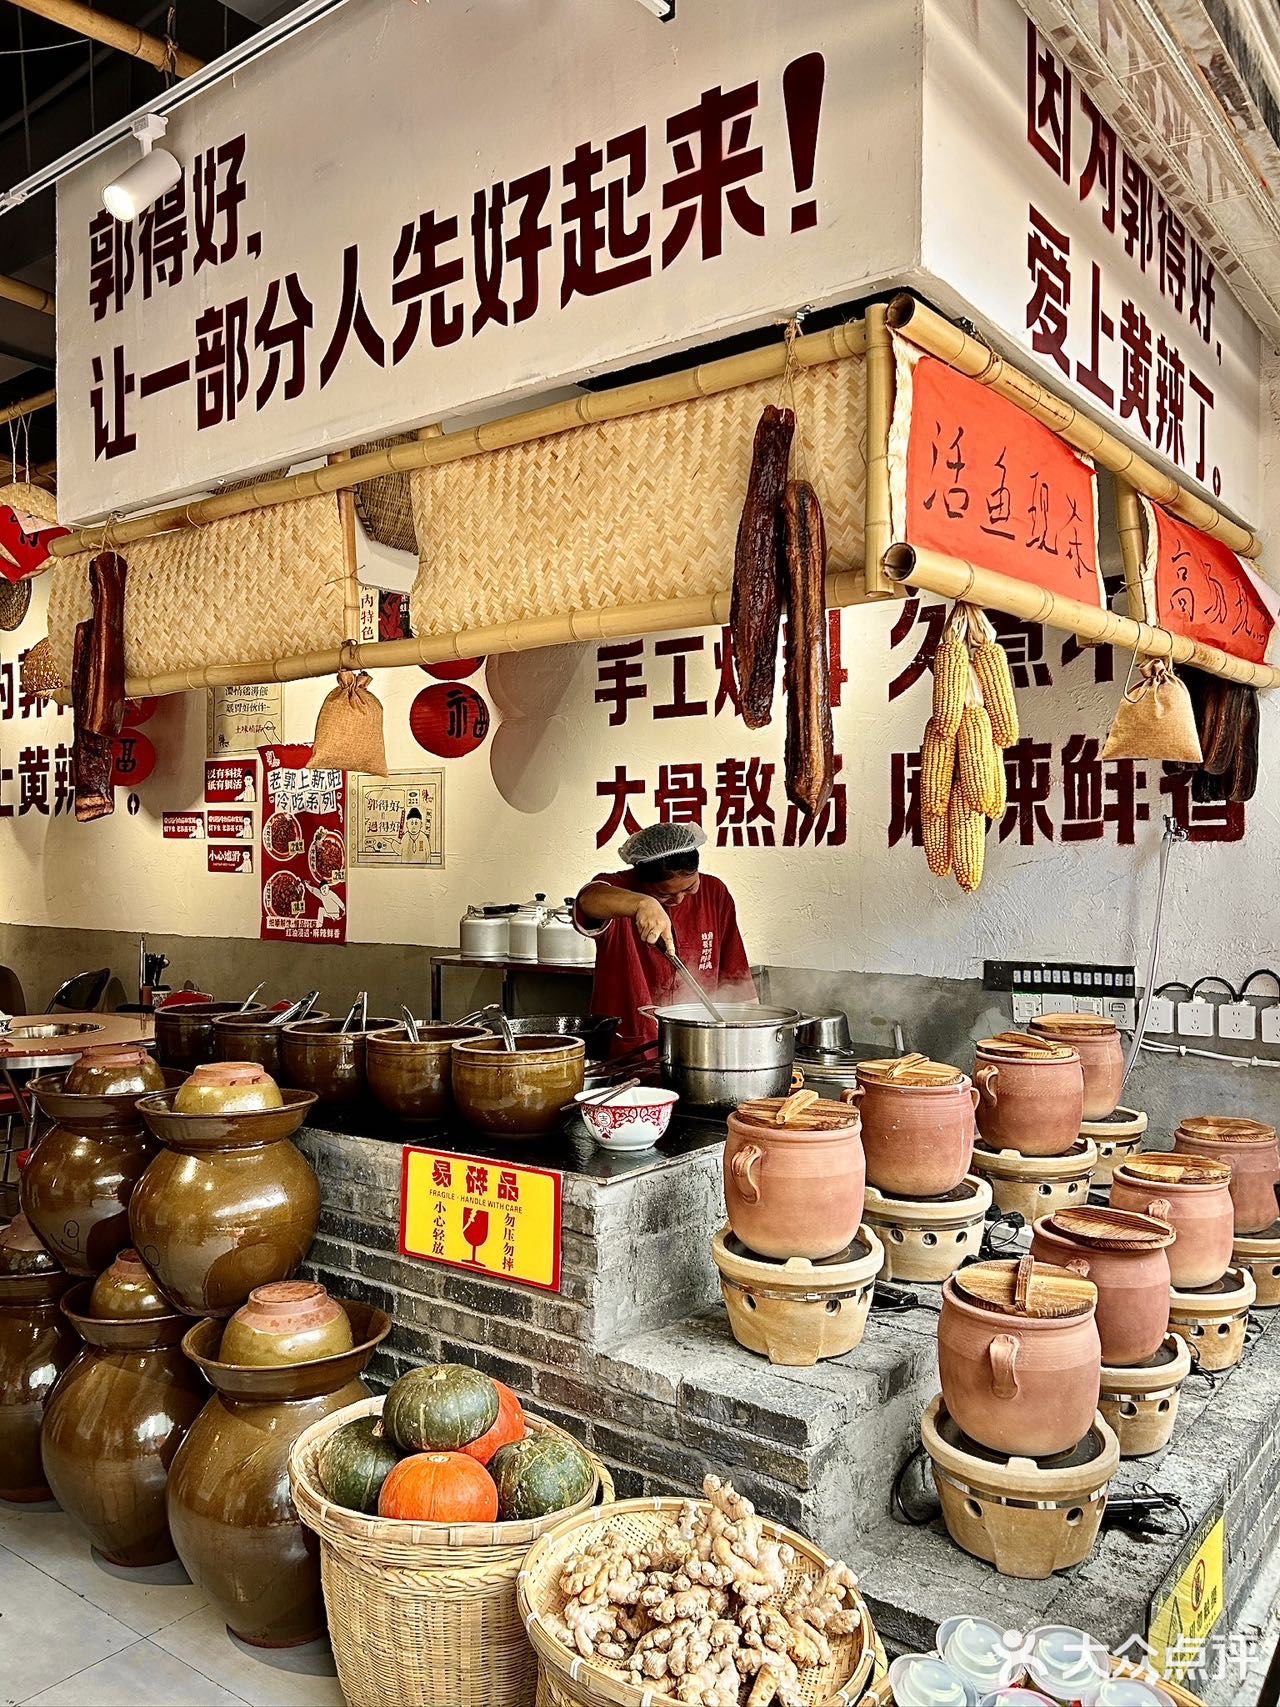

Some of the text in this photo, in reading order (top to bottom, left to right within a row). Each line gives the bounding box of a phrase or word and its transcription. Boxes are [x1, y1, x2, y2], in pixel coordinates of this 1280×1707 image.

[89, 133, 262, 323] 郭得好，
[90, 51, 825, 463] 让一部分人先好起来！
[1026, 203, 1222, 497] 爱上黄辣丁。
[0, 743, 140, 818] 黄辣。
[269, 769, 341, 791] 老郭上新啦
[276, 791, 335, 811] 冷吃系列
[367, 798, 400, 812] 郭得好
[596, 757, 847, 850] 大骨熬汤
[429, 1188, 523, 1214] FRAGILE HANDLE WITH CARE
[431, 1159, 519, 1202] 易碎品
[431, 1201, 447, 1256] 小心轻放
[502, 1213, 516, 1271] 勿压勿摔
